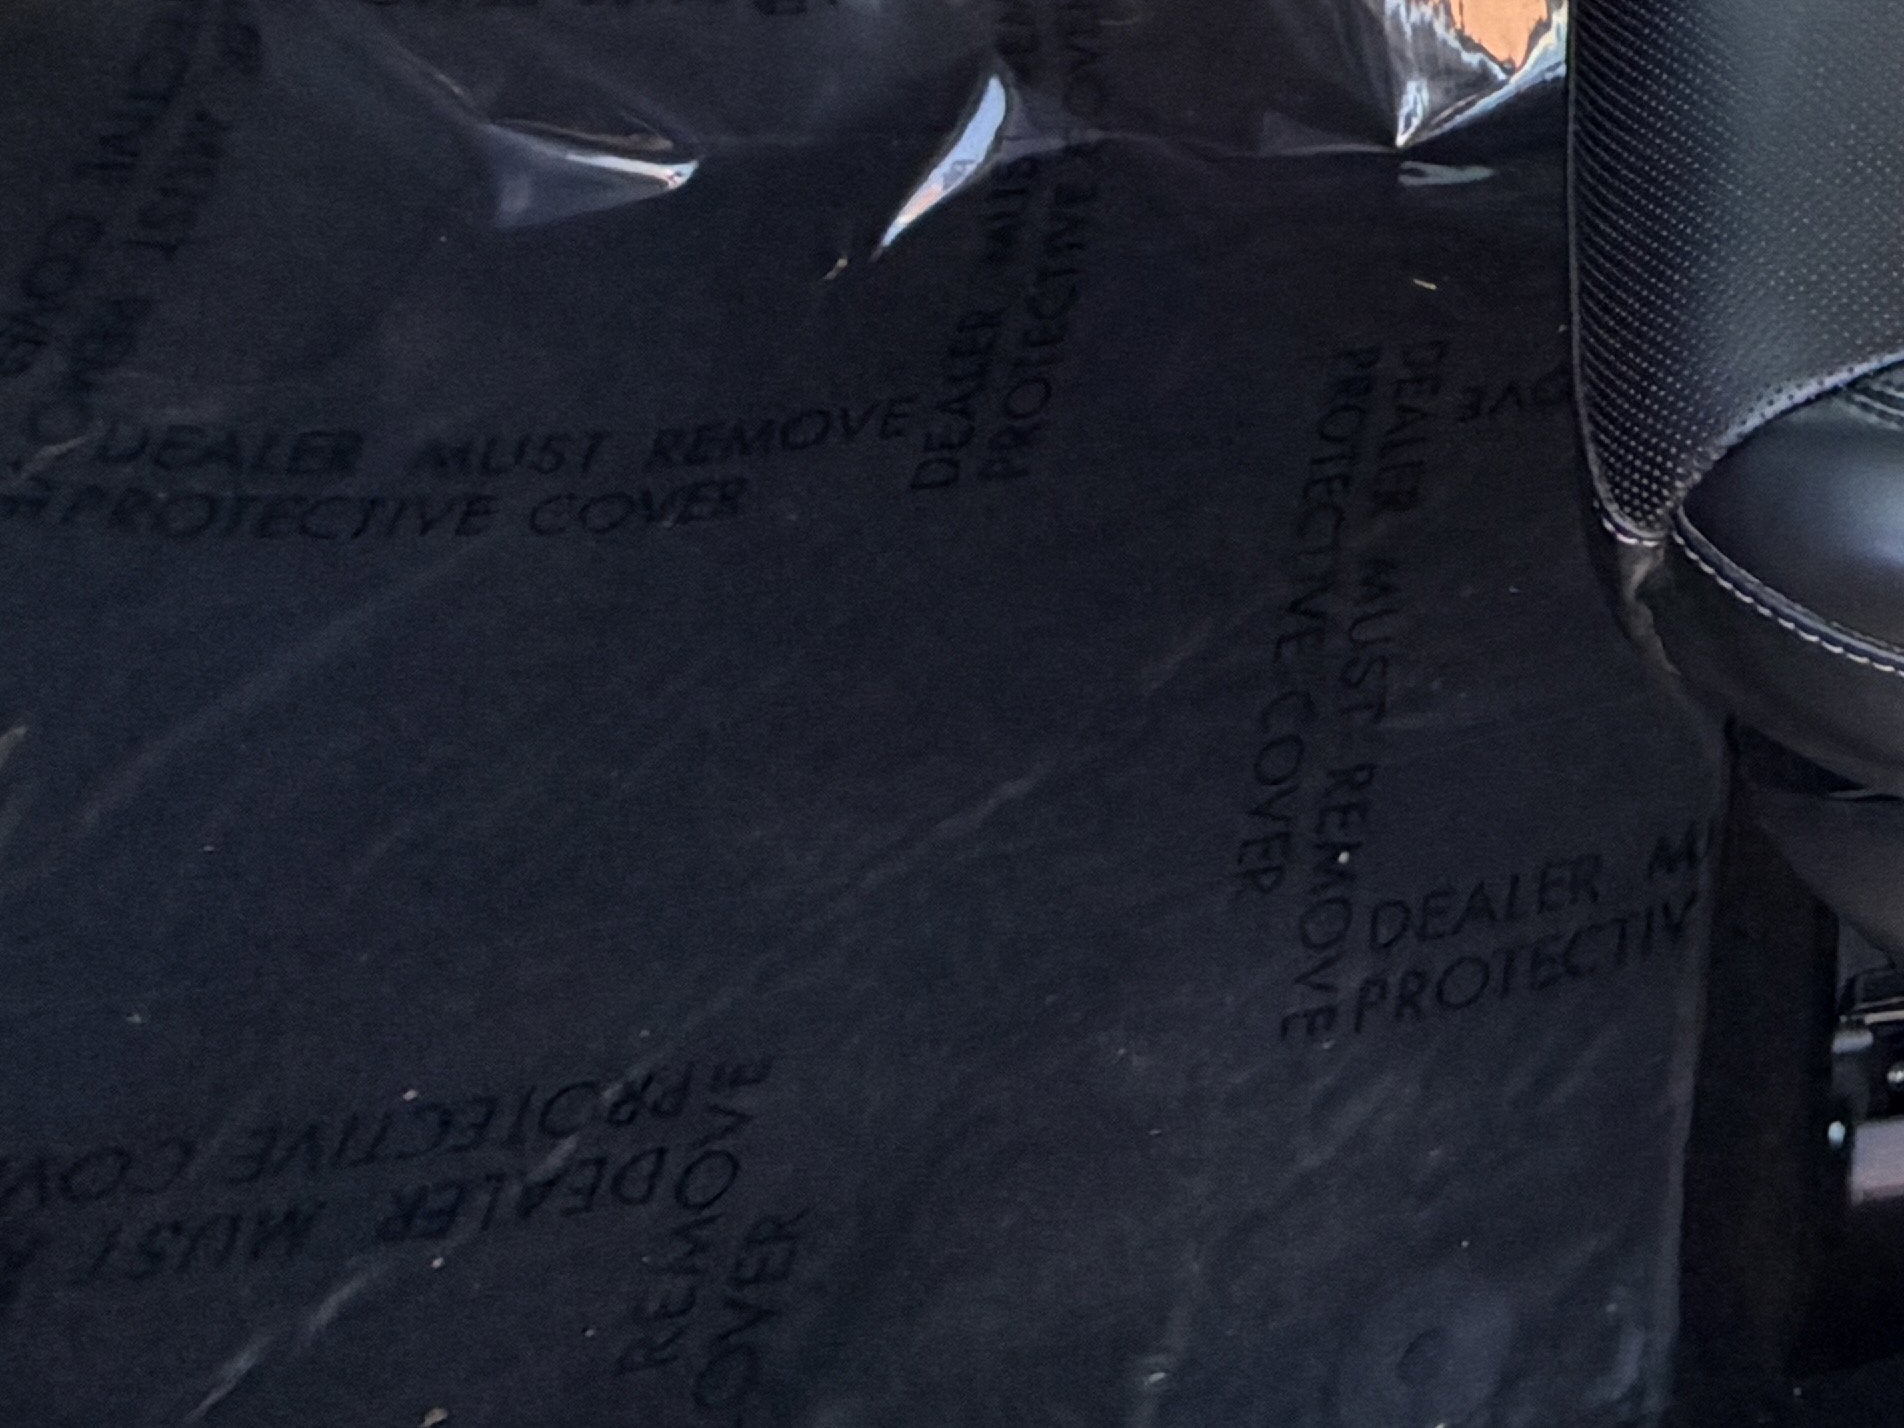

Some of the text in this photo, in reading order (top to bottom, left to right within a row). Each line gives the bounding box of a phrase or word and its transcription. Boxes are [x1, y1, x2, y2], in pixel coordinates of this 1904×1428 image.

[98, 394, 918, 477] DEALER MUST REMOVE
[527, 477, 750, 539] COVER
[1371, 852, 1602, 954] DEALER
[1355, 890, 1698, 1033] PROTECTIV
